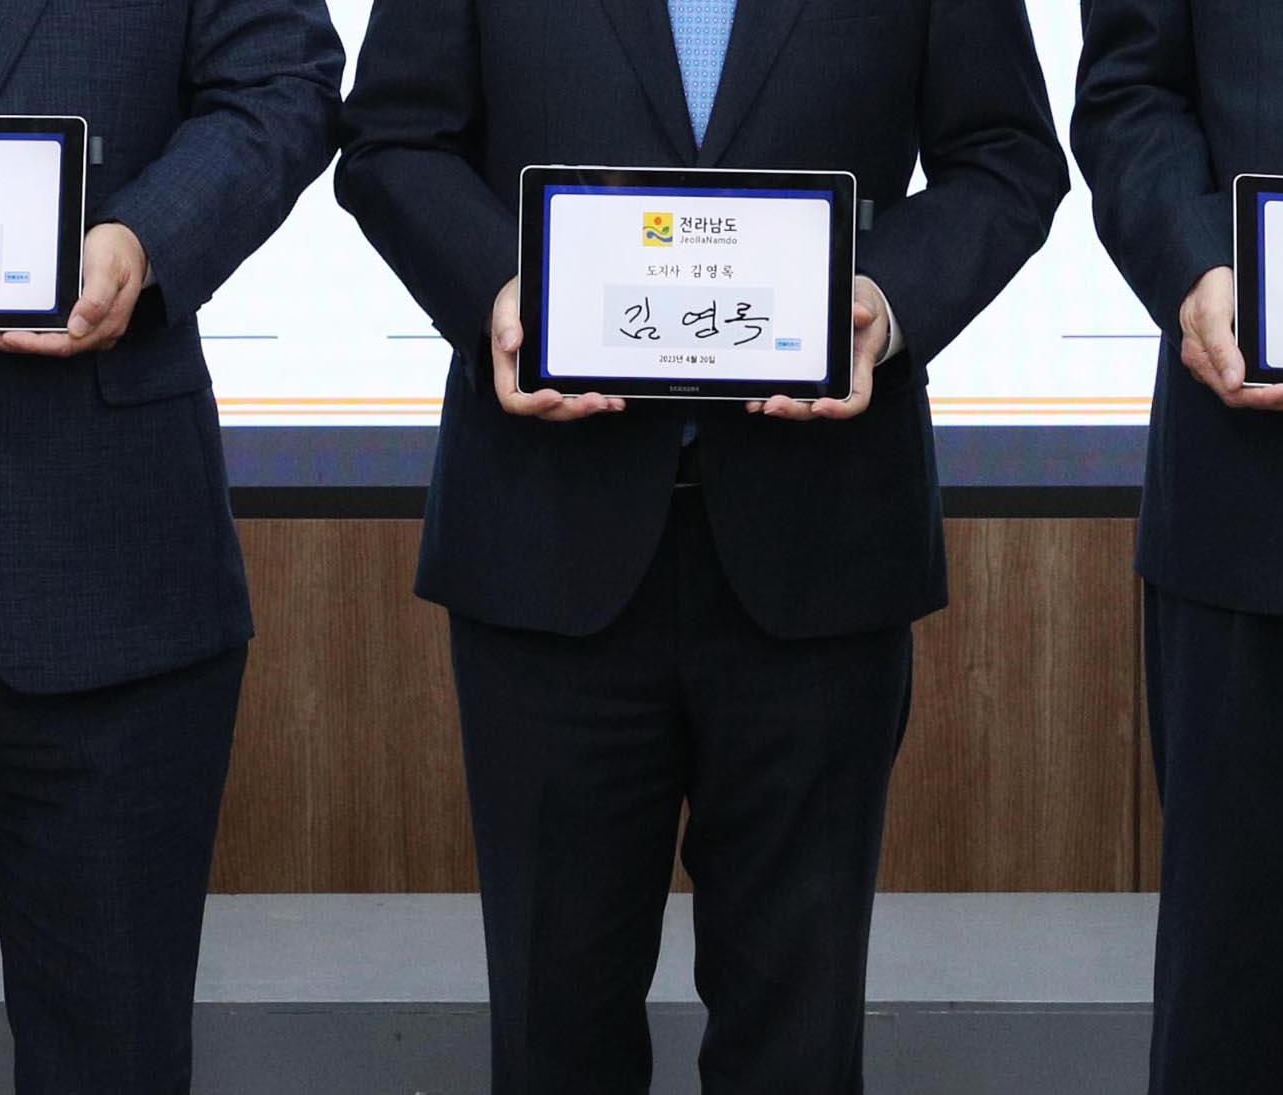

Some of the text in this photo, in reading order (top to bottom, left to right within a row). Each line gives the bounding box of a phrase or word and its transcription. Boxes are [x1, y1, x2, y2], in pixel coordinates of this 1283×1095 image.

[680, 217, 738, 234] 전라남도
[680, 235, 738, 245] JeollaNamdo
[646, 264, 681, 278] 도지사
